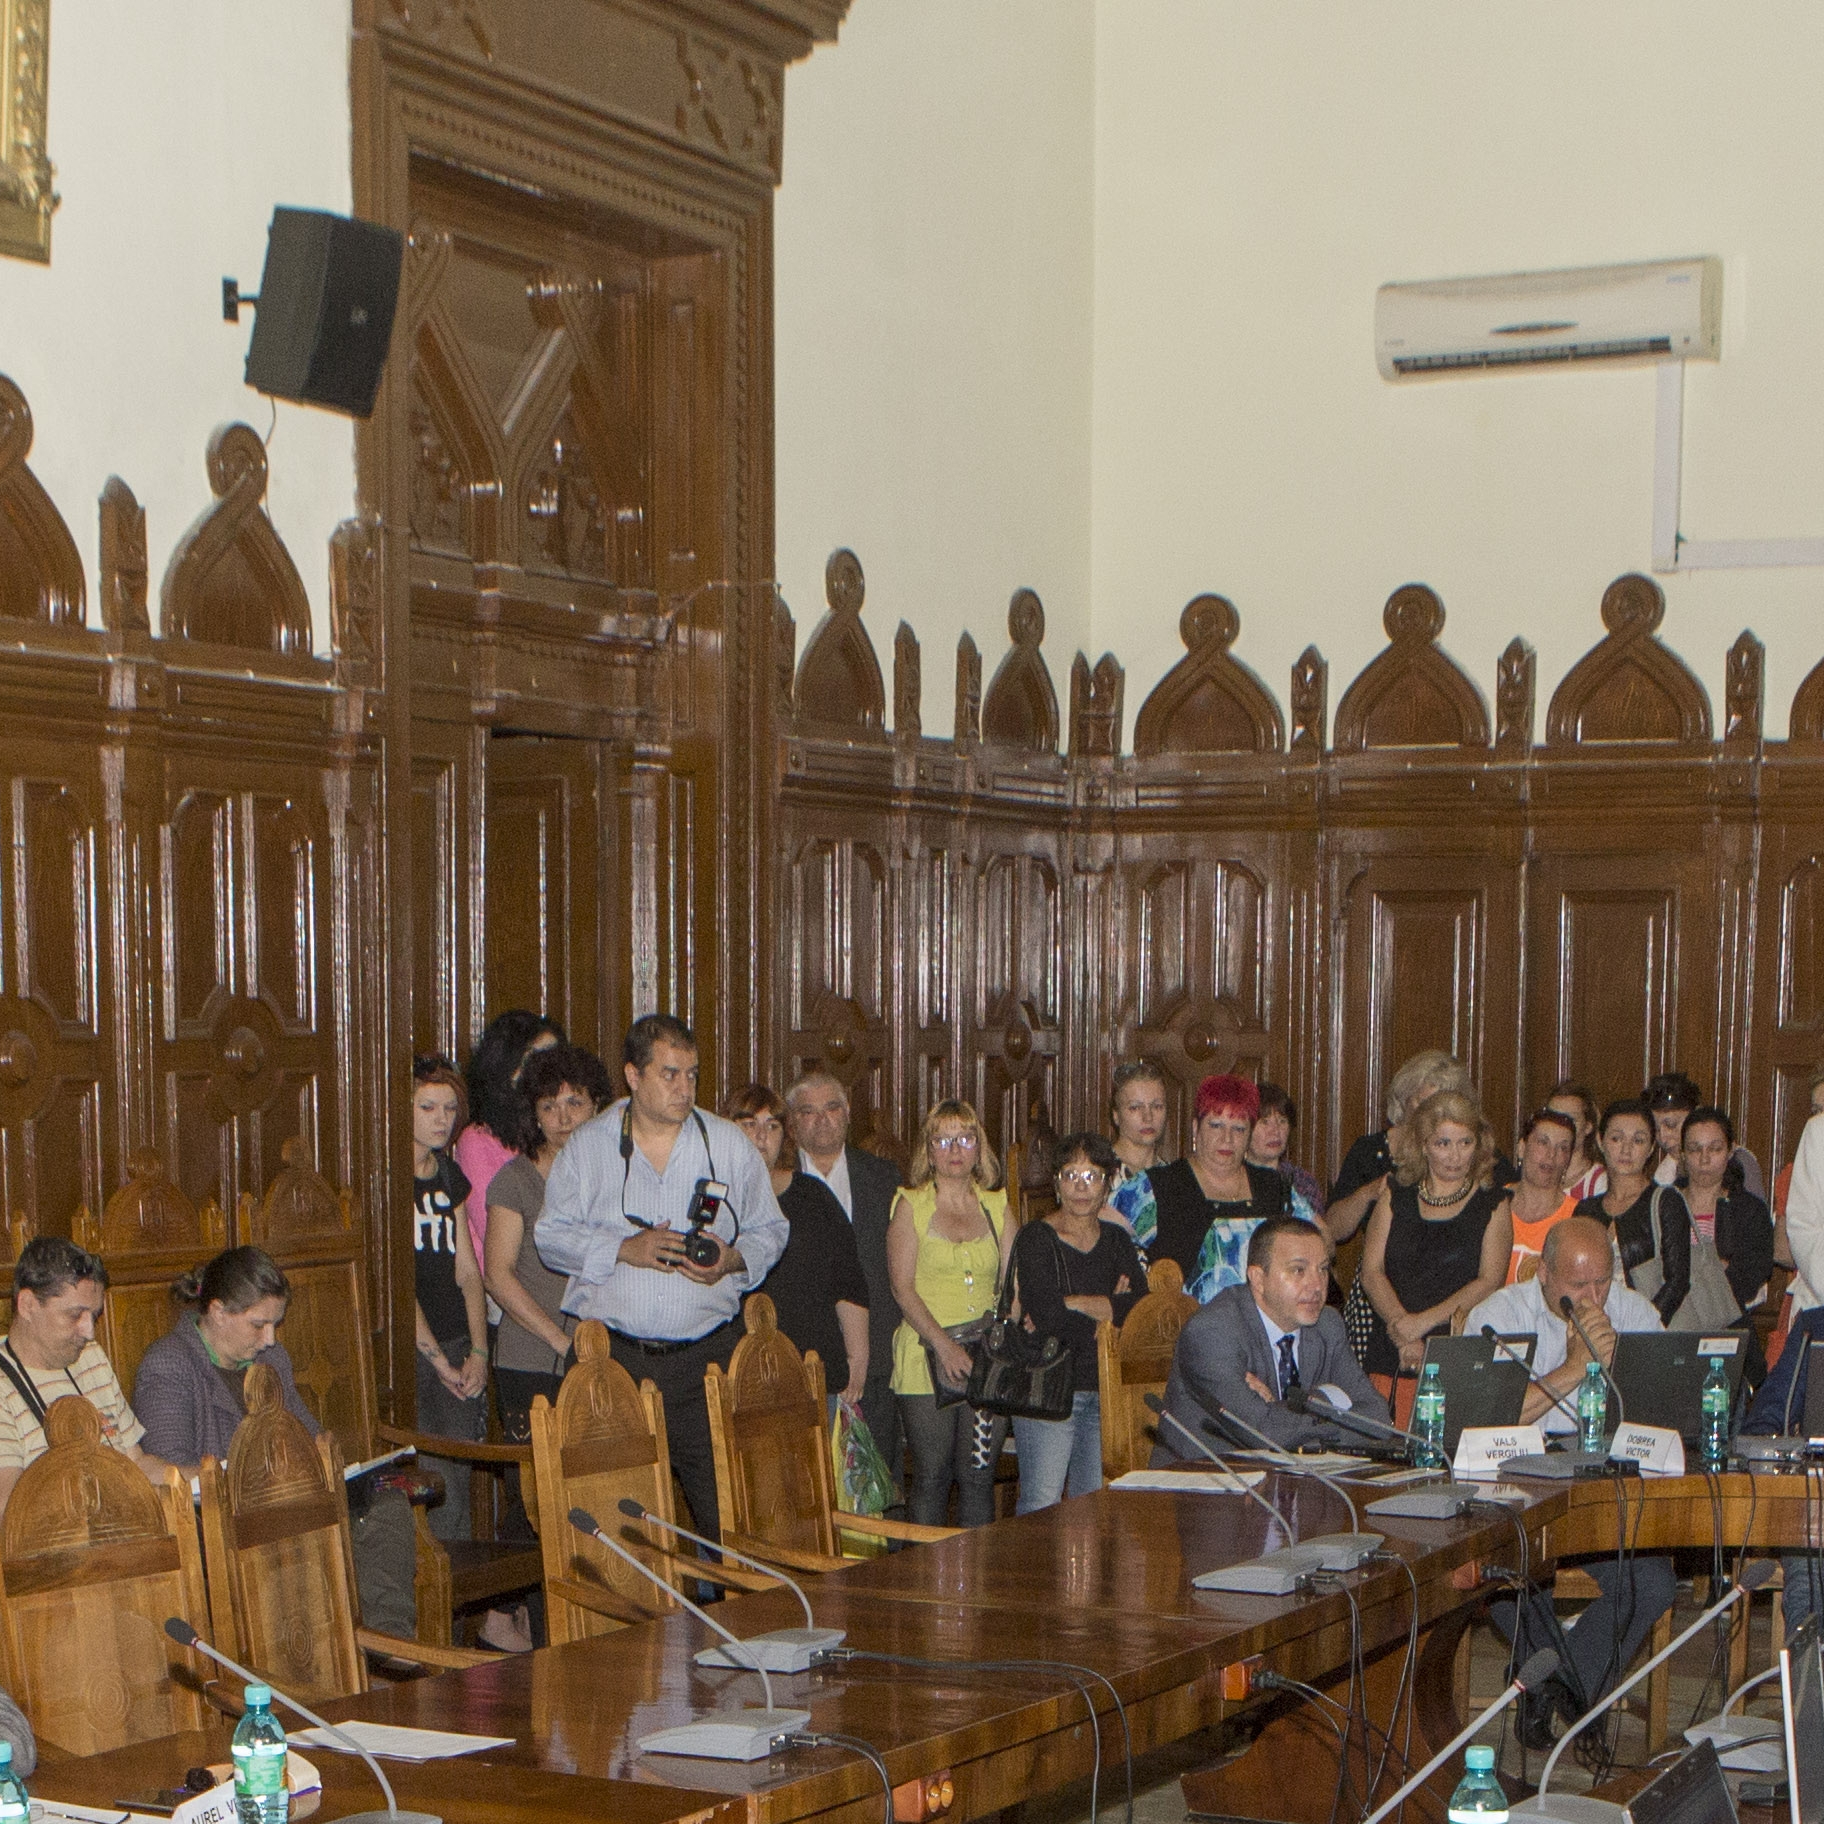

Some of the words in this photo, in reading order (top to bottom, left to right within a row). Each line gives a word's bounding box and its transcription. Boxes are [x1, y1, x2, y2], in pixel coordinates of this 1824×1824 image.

[1492, 1437, 1517, 1448] VALS
[1626, 1435, 1656, 1447] DOBREA
[1625, 1447, 1650, 1459] VICTOR
